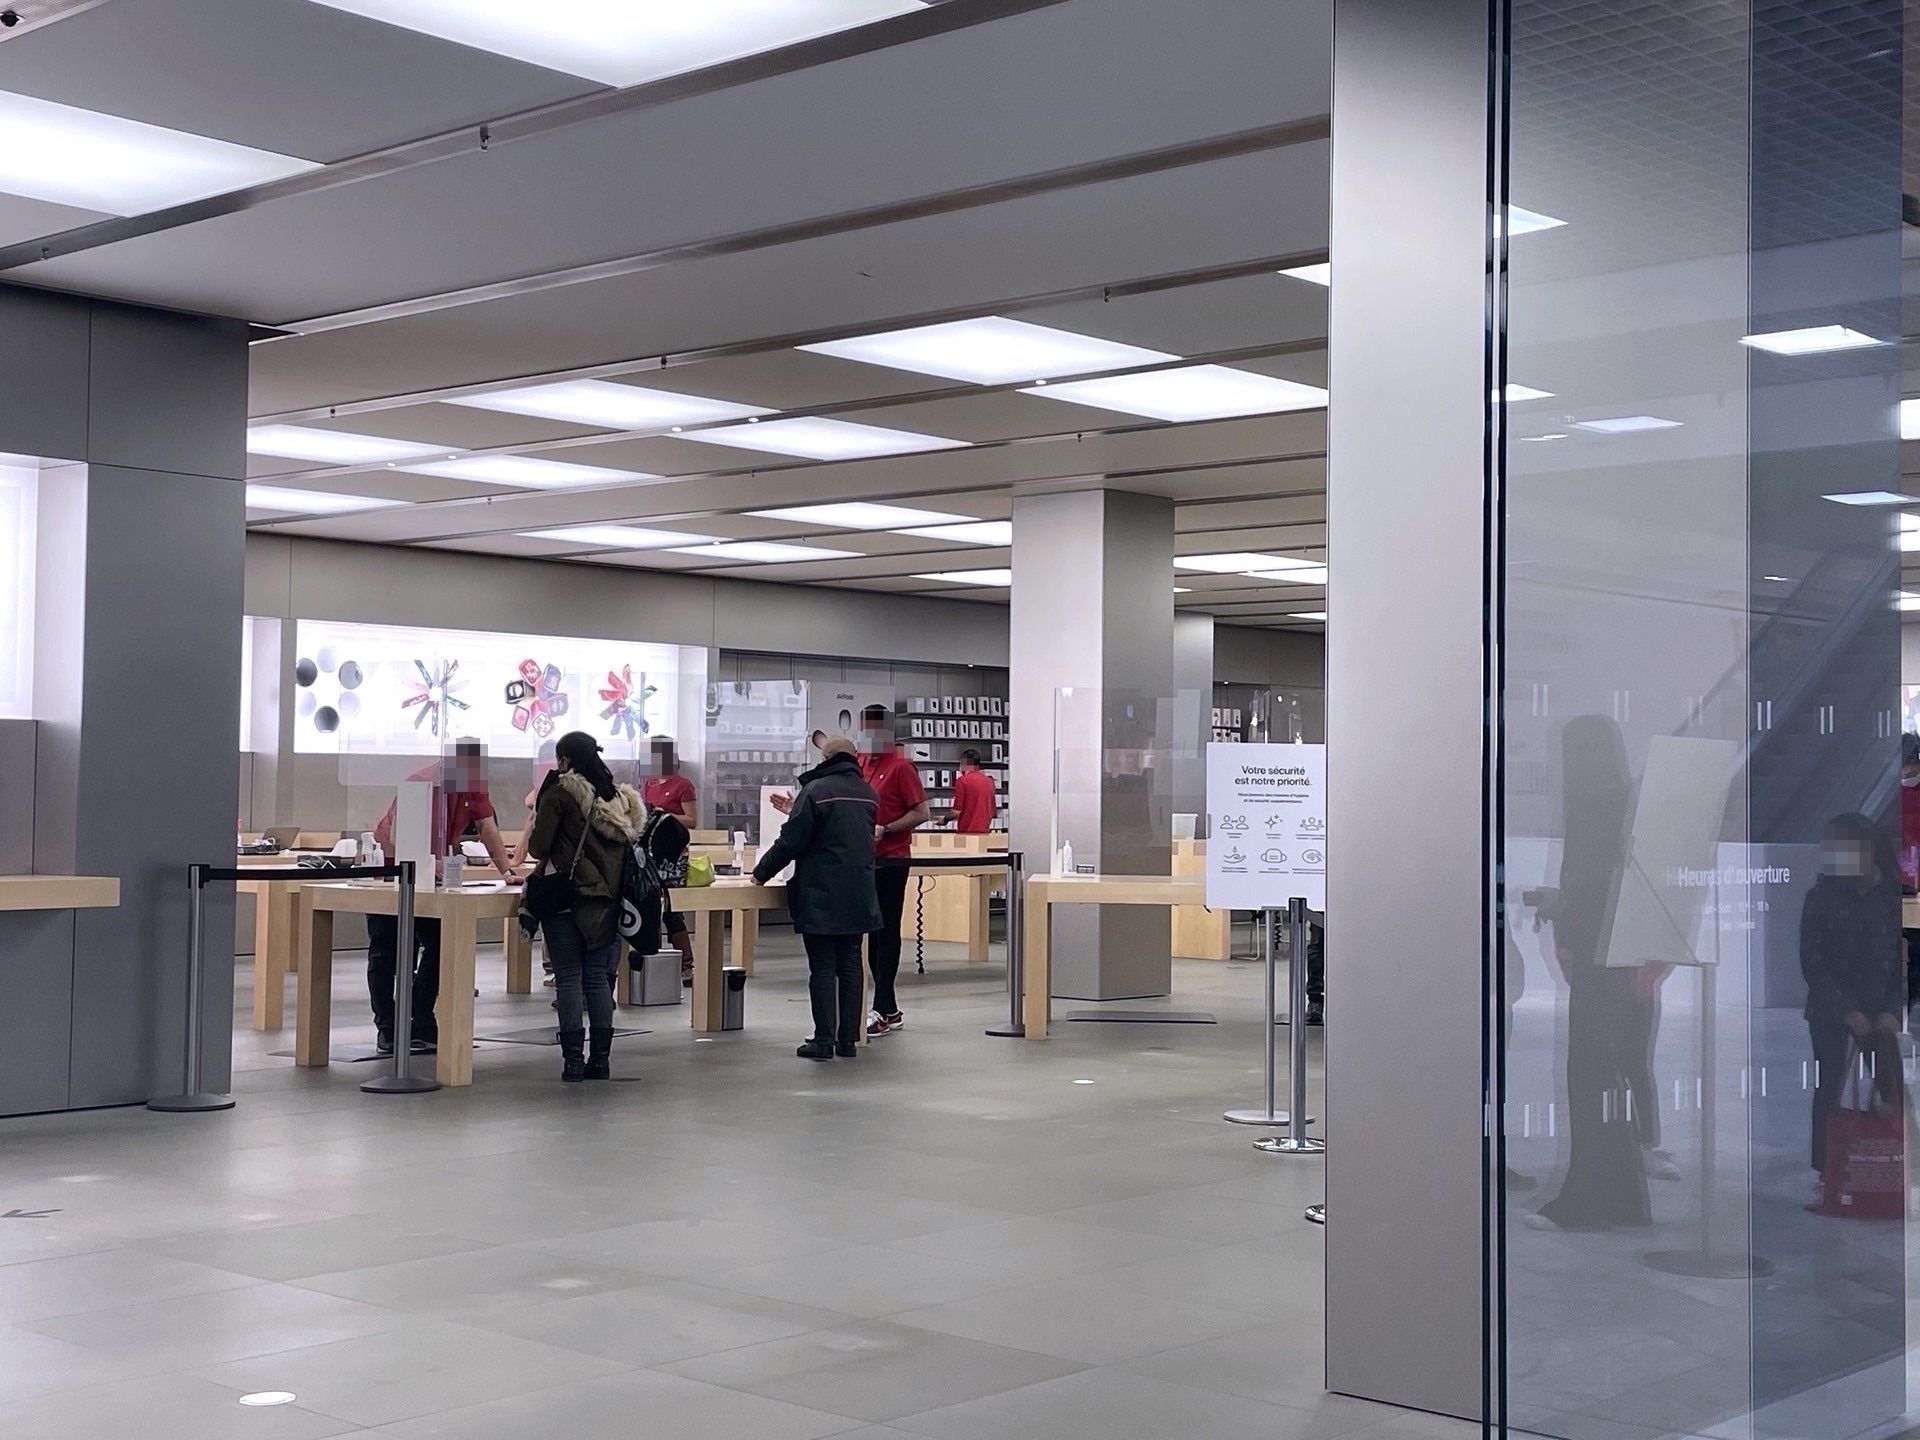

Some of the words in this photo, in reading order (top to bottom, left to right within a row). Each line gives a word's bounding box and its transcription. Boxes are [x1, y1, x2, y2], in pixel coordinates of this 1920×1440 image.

[1241, 765, 1266, 775] Votre
[1267, 765, 1306, 775] sécurité
[1234, 777, 1249, 785] est
[1251, 777, 1275, 786] notre
